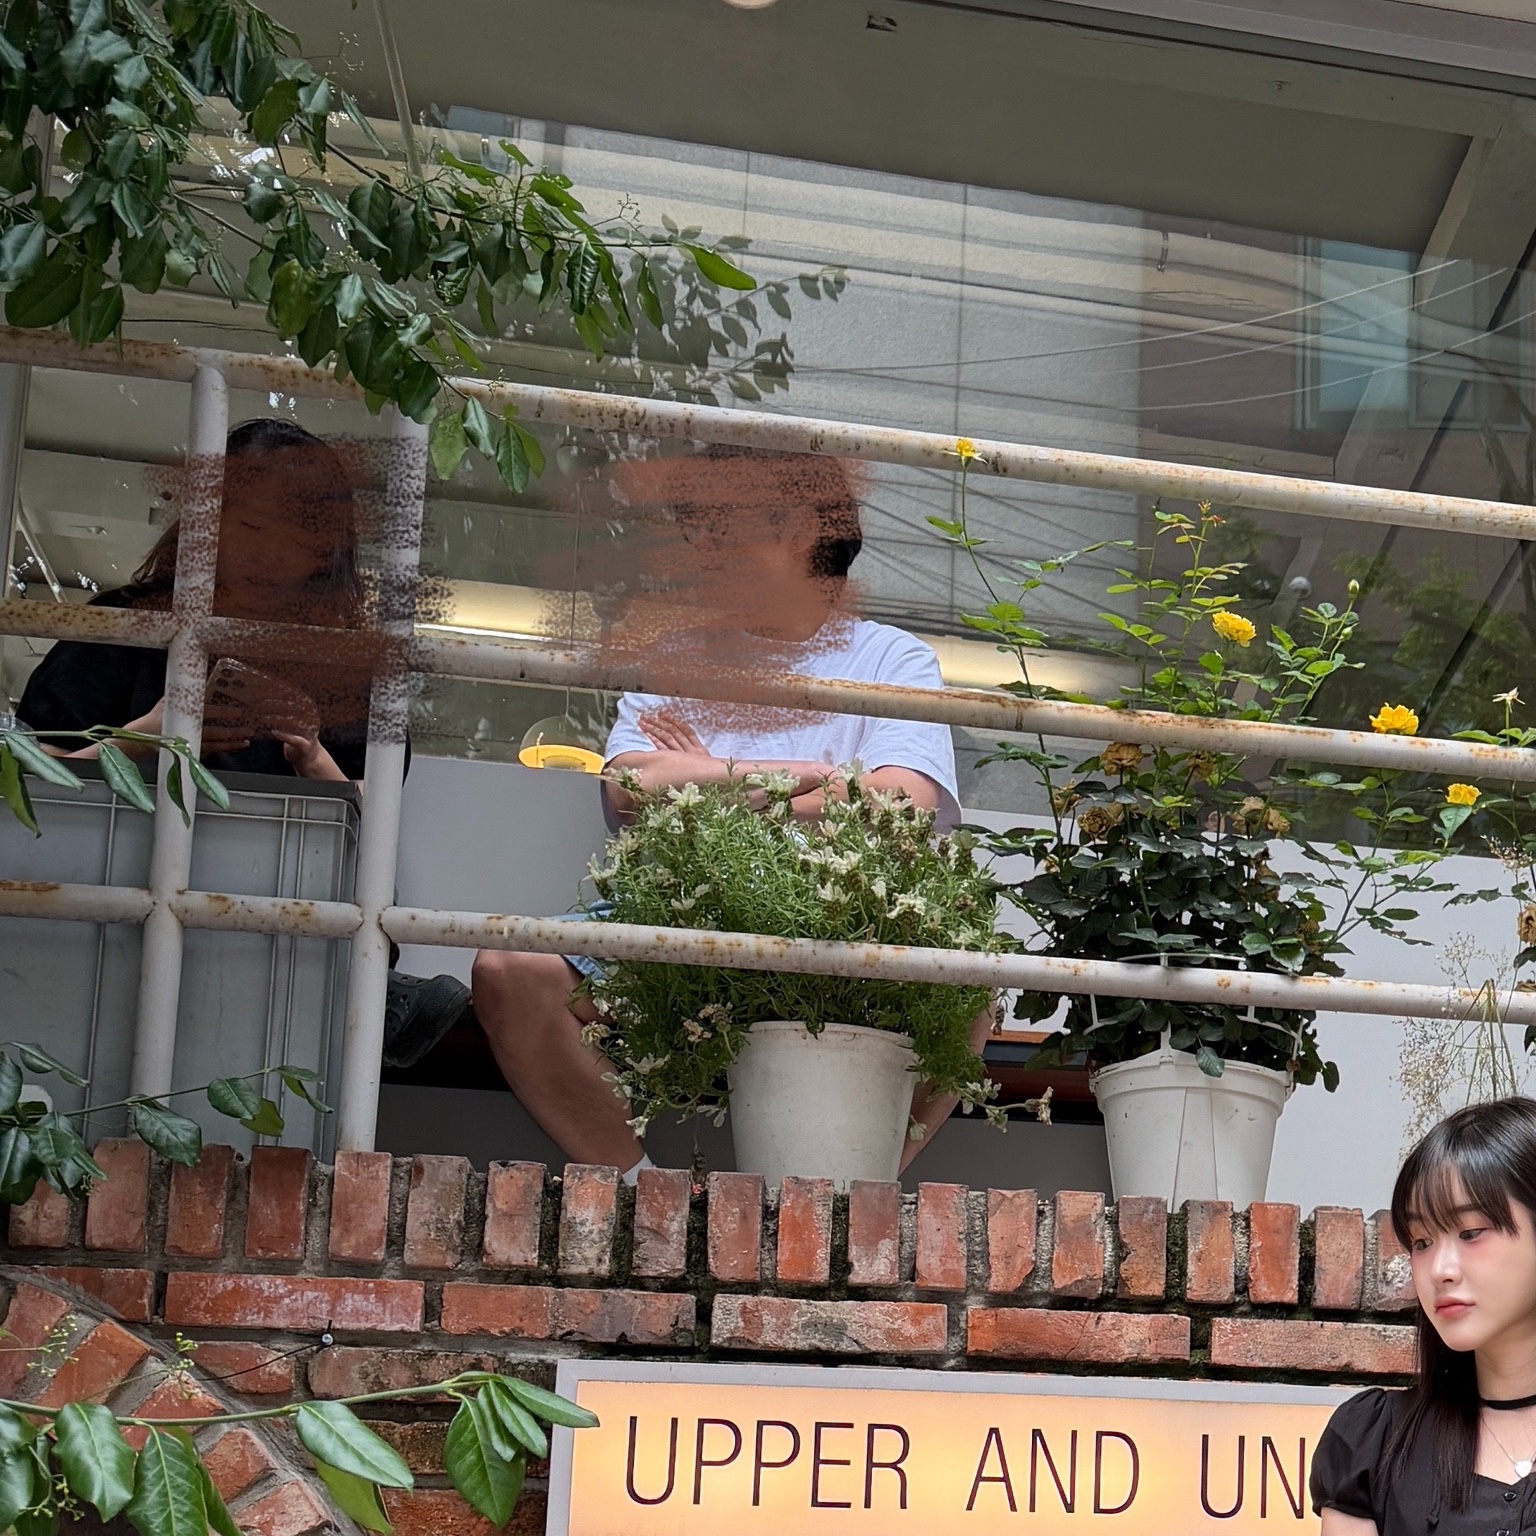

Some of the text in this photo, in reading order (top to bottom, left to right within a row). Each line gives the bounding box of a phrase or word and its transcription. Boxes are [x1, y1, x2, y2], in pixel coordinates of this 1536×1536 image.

[625, 1414, 1307, 1520] UPPER AND UN
